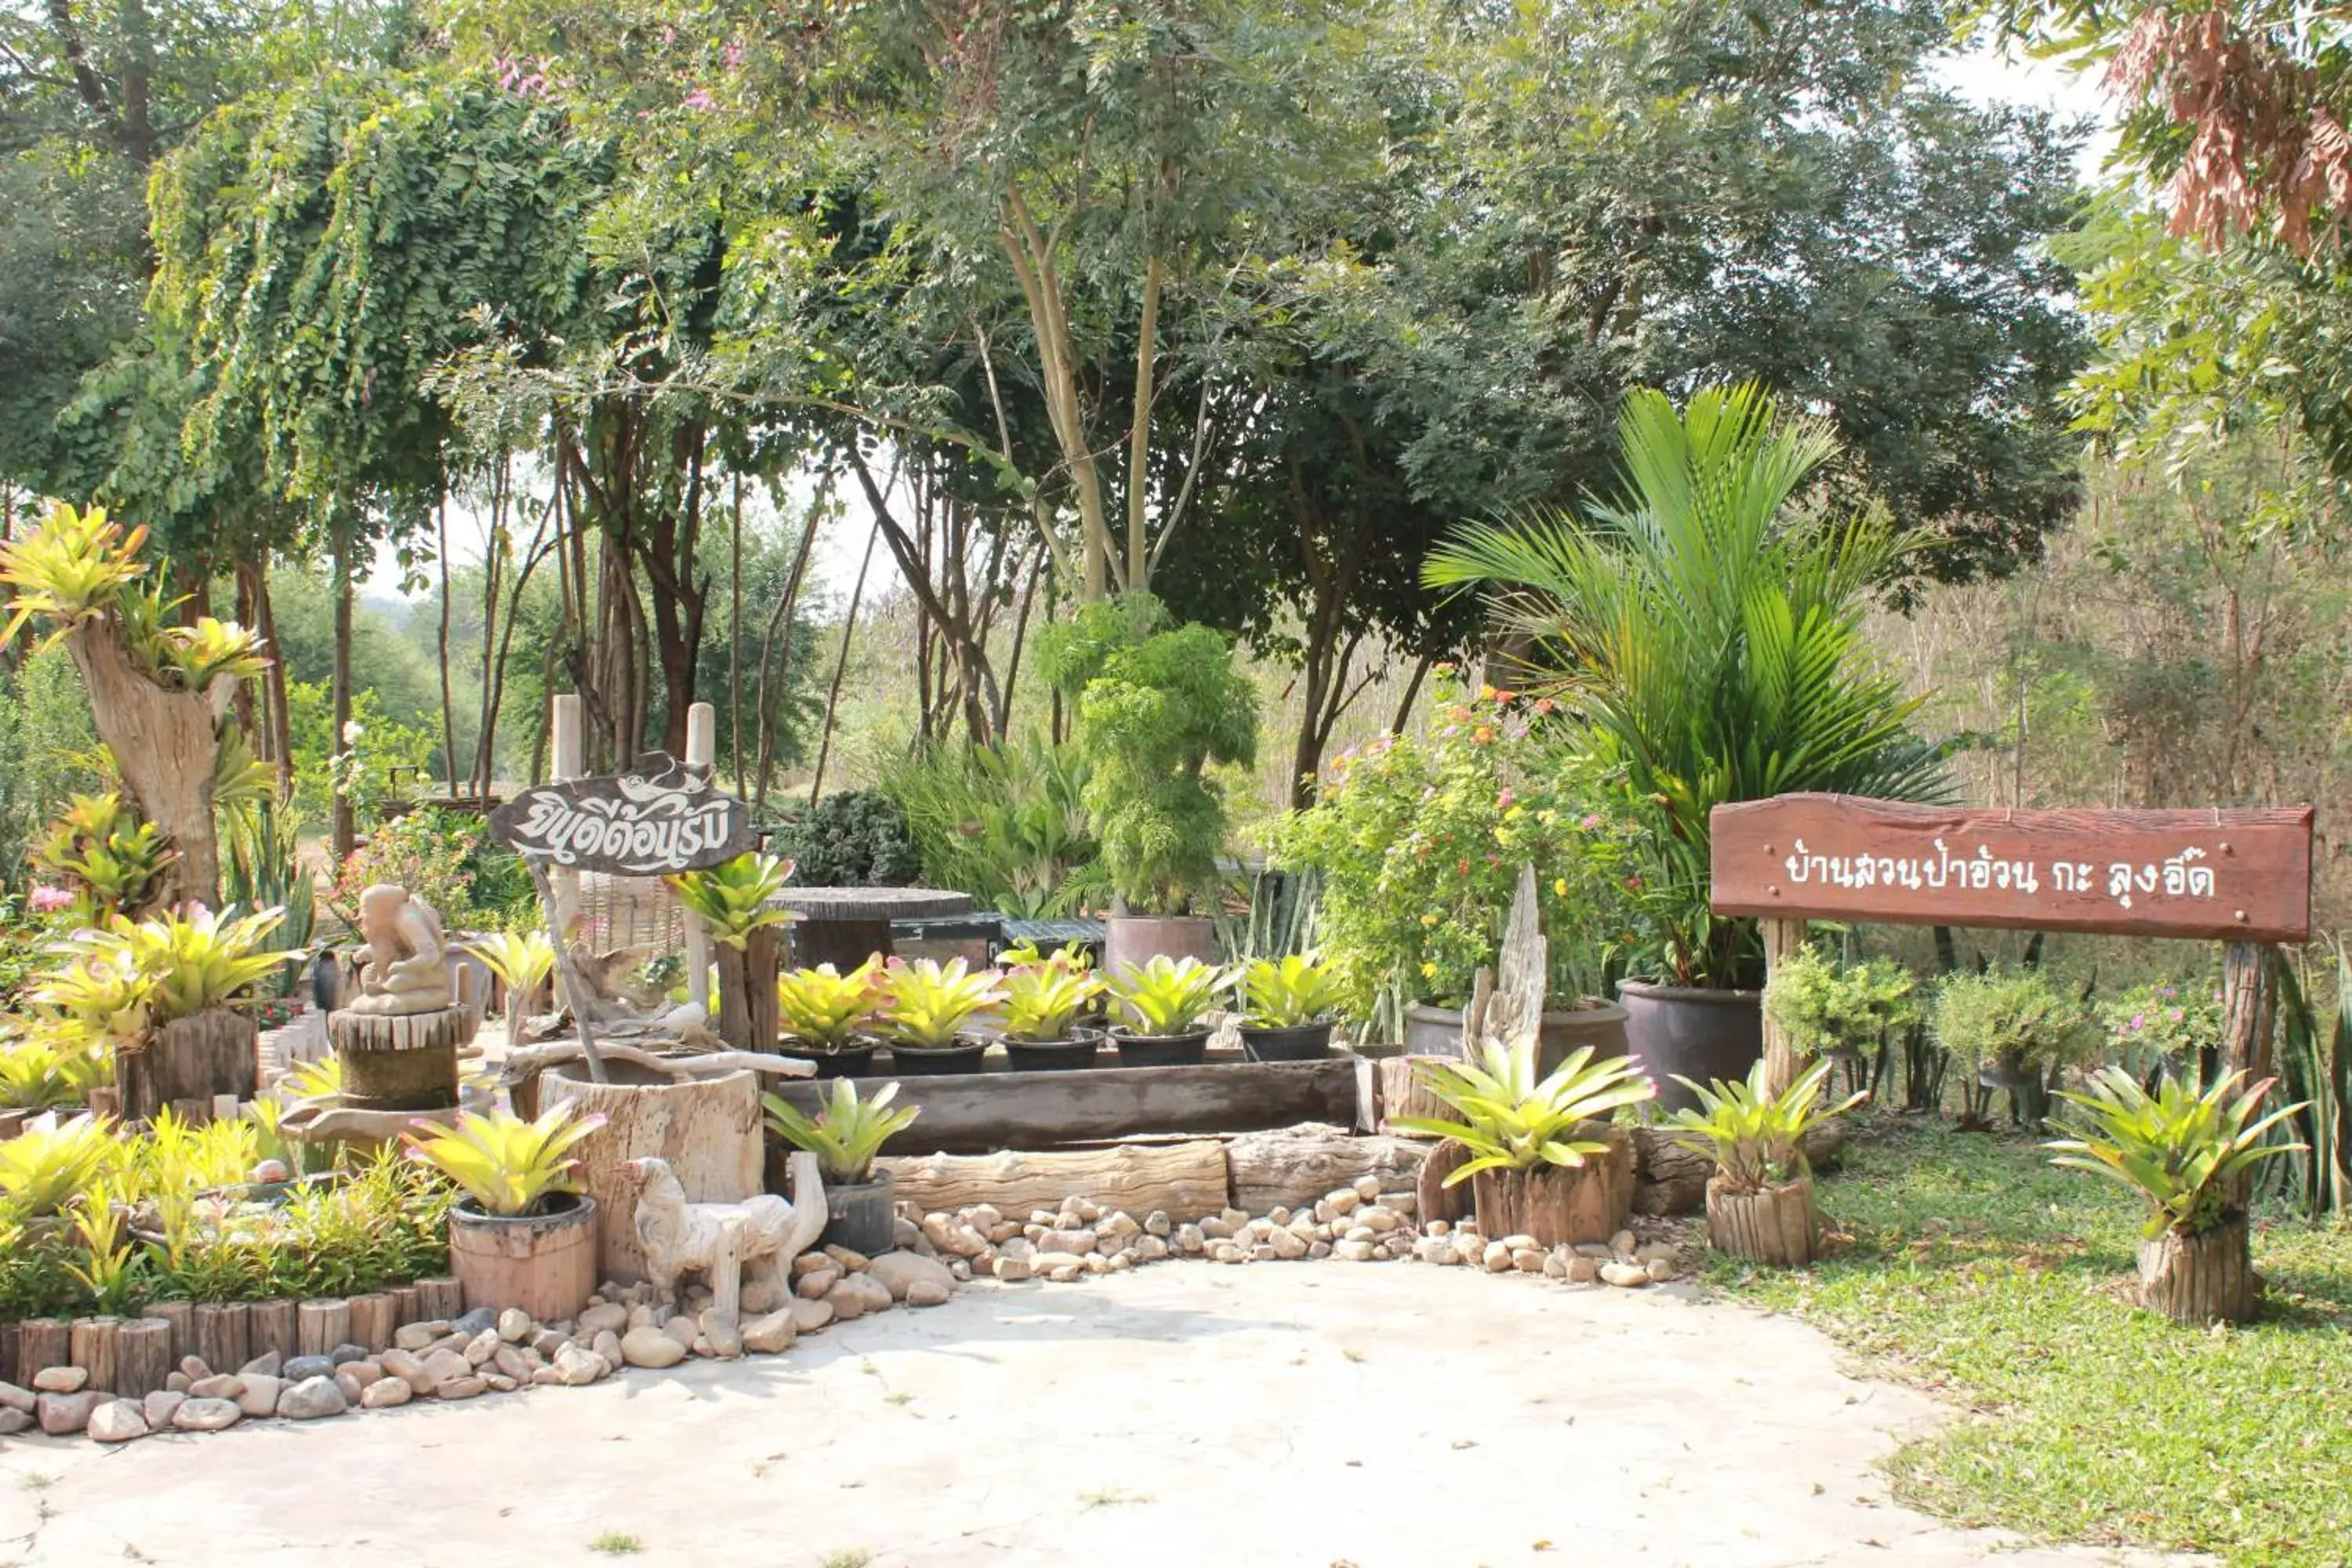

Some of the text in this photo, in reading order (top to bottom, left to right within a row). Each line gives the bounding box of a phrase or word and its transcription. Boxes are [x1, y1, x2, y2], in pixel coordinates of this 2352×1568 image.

[511, 790, 731, 870] ยินดีต้อนรับ
[1785, 838, 2039, 894] บ้านสวนป้าอ้วน
[2052, 862, 2094, 891] กะ
